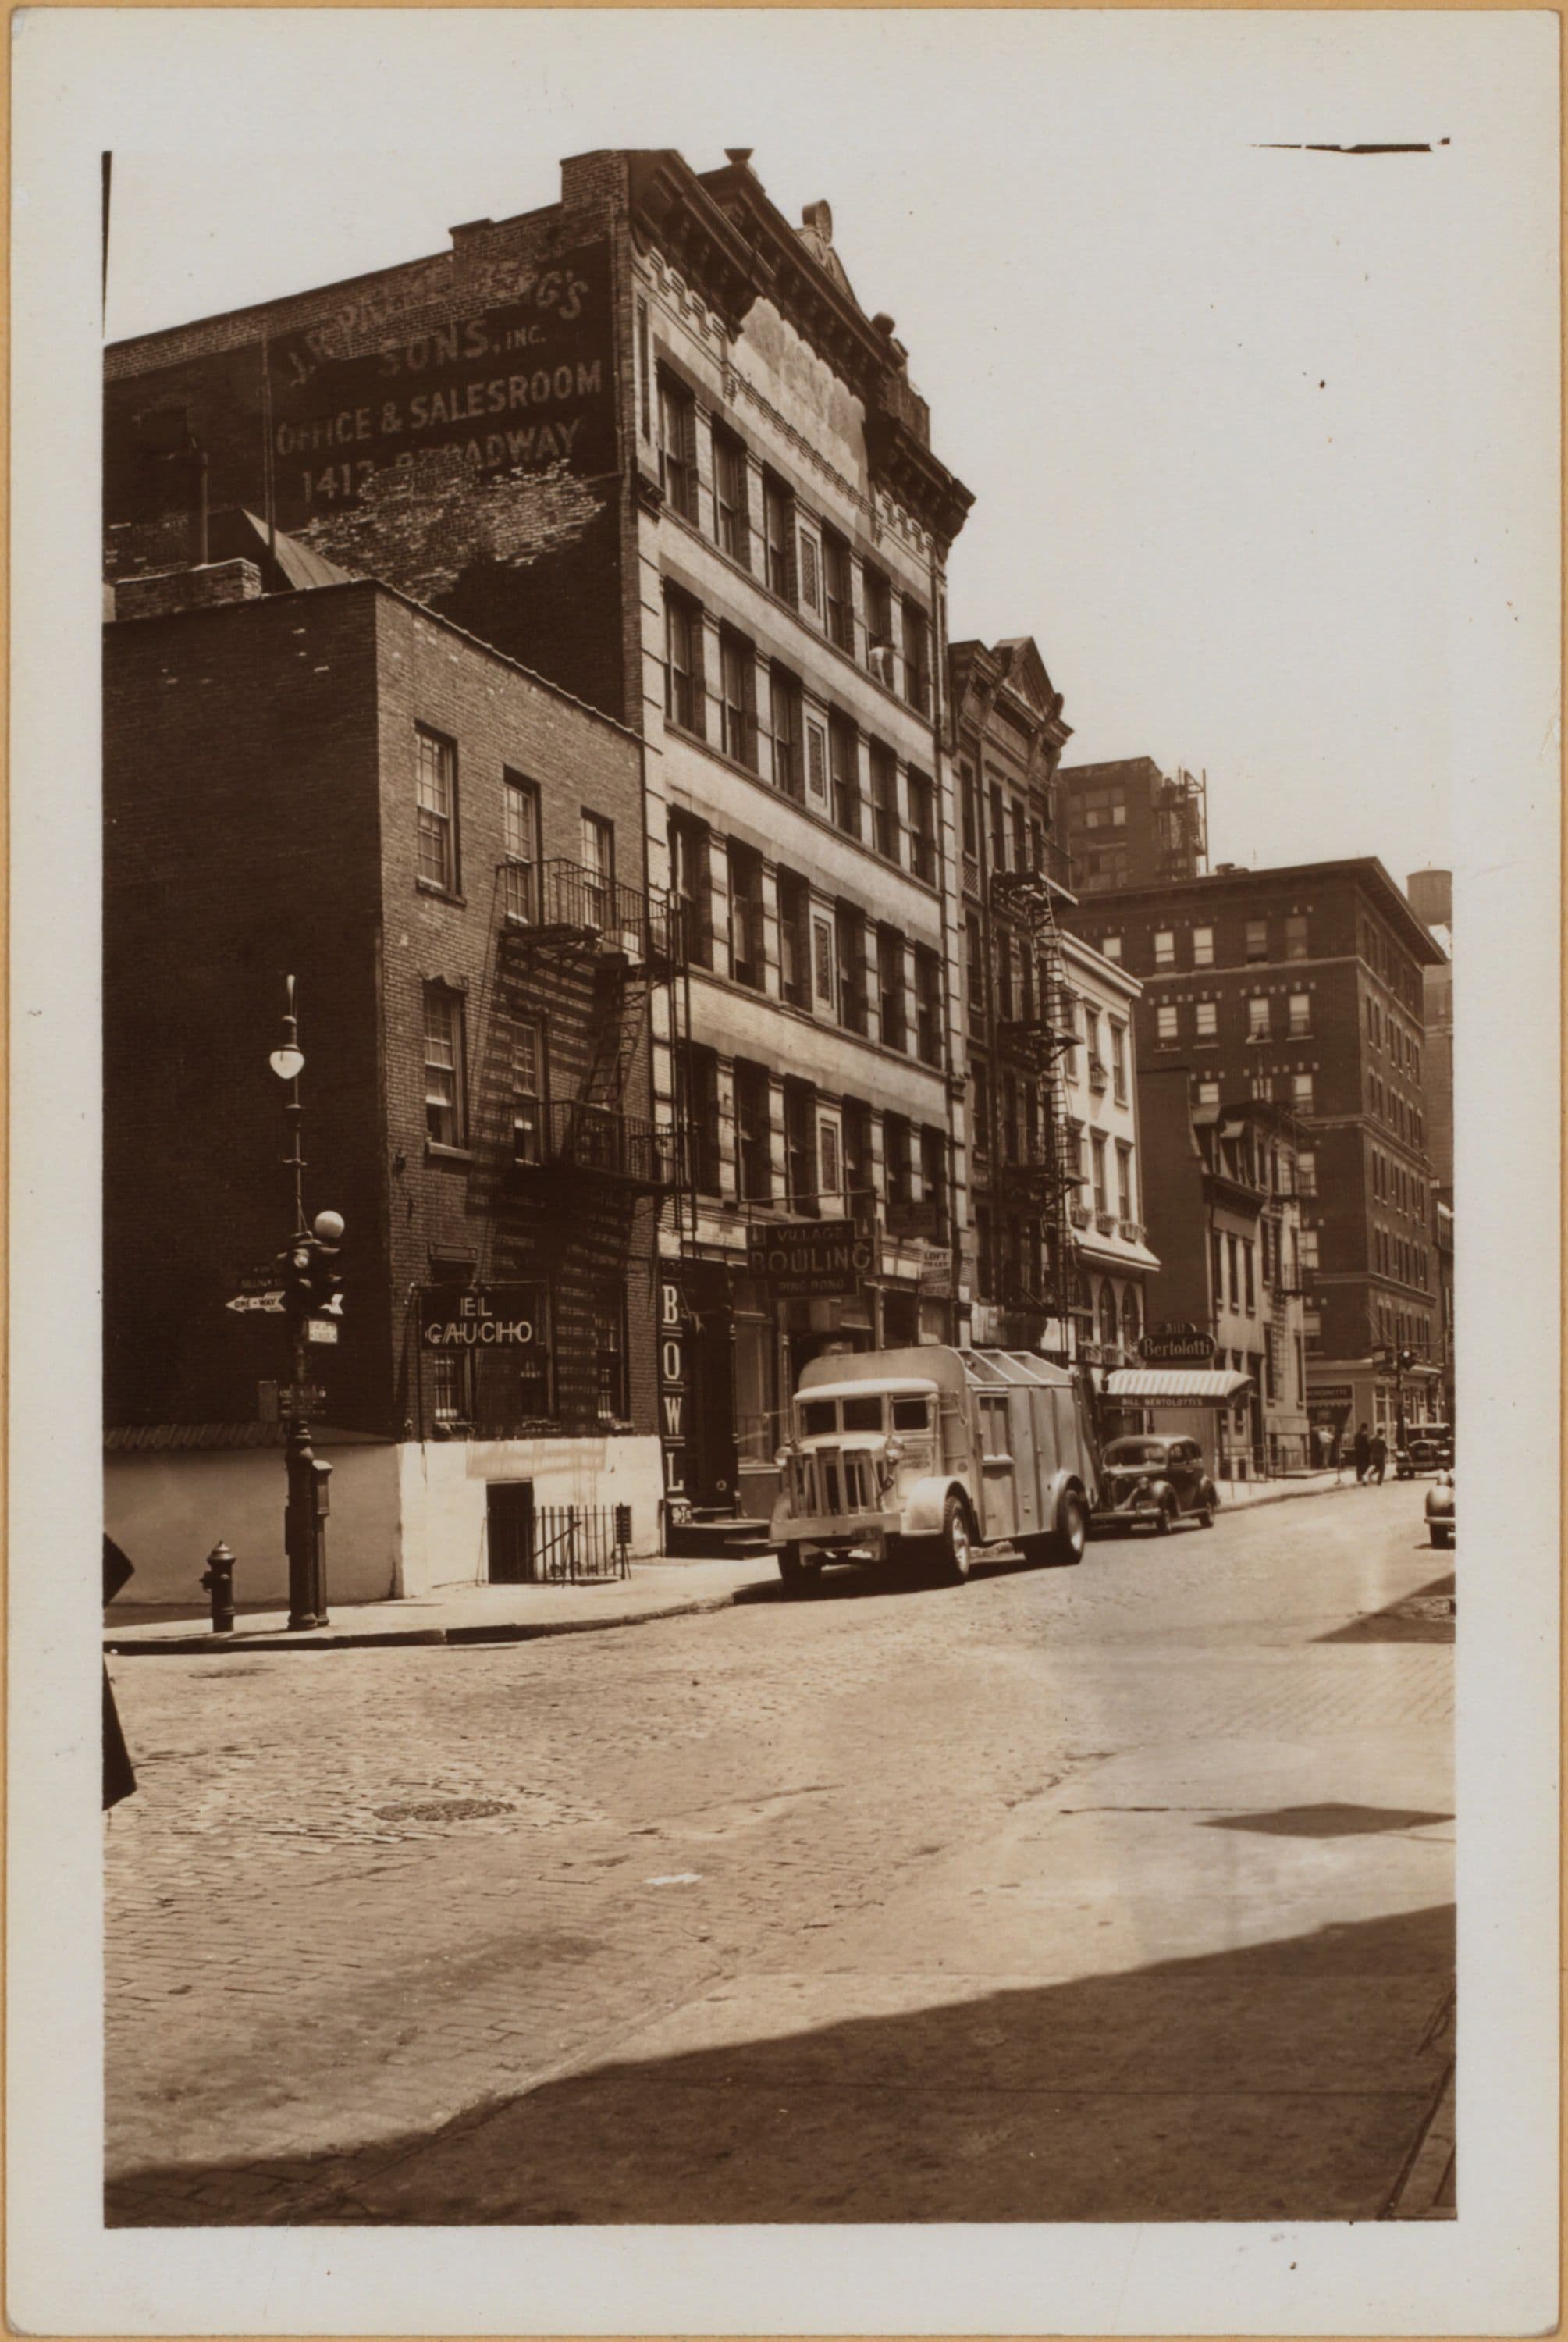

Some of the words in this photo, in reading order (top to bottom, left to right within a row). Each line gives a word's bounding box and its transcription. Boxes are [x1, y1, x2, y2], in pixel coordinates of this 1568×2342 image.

[506, 325, 547, 351] INC.
[382, 400, 403, 434] &
[410, 359, 602, 430] SALESROOM
[751, 1241, 871, 1273] BOWLING
[234, 1300, 251, 1309] ONE
[460, 1297, 492, 1317] EL
[425, 1321, 533, 1344] GAUCHO
[1143, 1337, 1211, 1357] Bertolotti
[662, 1284, 685, 1493] BOWL
[1122, 1397, 1139, 1406] BILL
